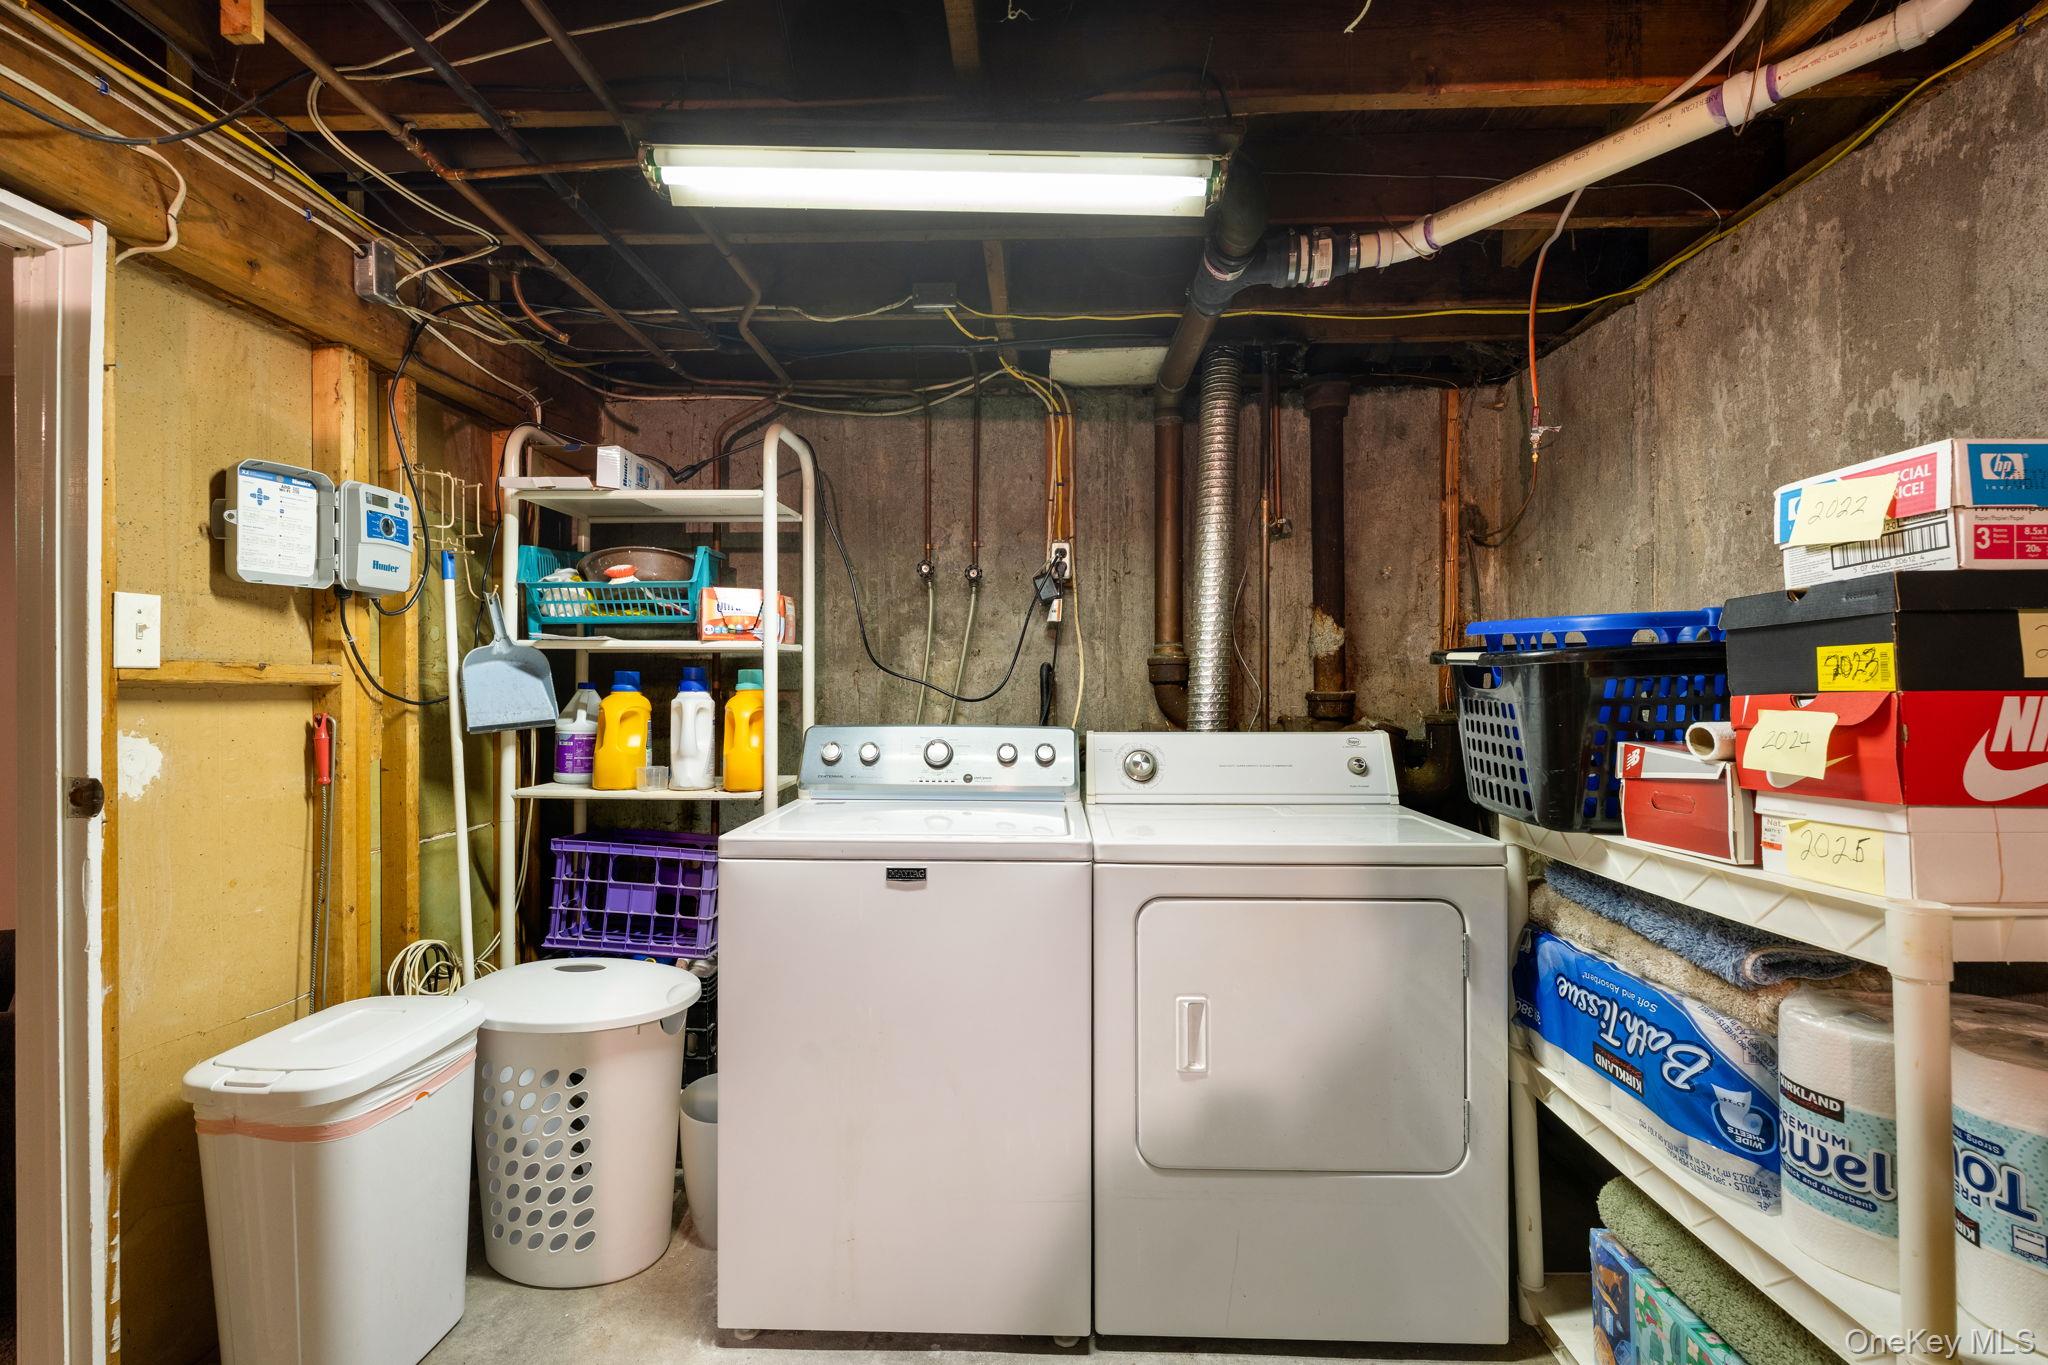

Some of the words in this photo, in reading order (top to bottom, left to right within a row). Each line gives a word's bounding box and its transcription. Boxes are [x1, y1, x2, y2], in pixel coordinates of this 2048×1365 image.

[1680, 93, 1718, 114] AMERICAN
[1658, 113, 1673, 125] PVC
[1899, 463, 1932, 482] ECIAL
[1808, 496, 1868, 525] 2022
[1976, 527, 1991, 549] 3
[372, 560, 400, 573] Hunter
[1990, 696, 2048, 752] NI
[1762, 731, 1811, 752] 2024
[1801, 829, 1871, 864] 2025
[888, 869, 925, 878] MAYTAG
[1621, 988, 1636, 1001] and
[1637, 996, 1659, 1013] Soft
[1556, 975, 1621, 1047] Tissue
[1717, 1019, 1739, 1041] SHEETS
[1619, 1008, 1713, 1091] Bath
[1595, 1053, 1643, 1094] KIRKLAND
[1780, 1075, 1841, 1112] KIRKLAND
[1727, 1126, 1766, 1144] SHEETS
[1780, 1111, 1846, 1151] REMIUM
[1735, 1137, 1763, 1150] WIDE
[1780, 1122, 1892, 1197] wel
[1689, 1162, 1713, 1181] SHEETS
[1735, 1181, 1759, 1196] ROLLS
[1802, 1175, 1818, 1188] and
[1821, 1185, 1873, 1211] Absorbent
[1955, 1179, 1981, 1208] PRE
